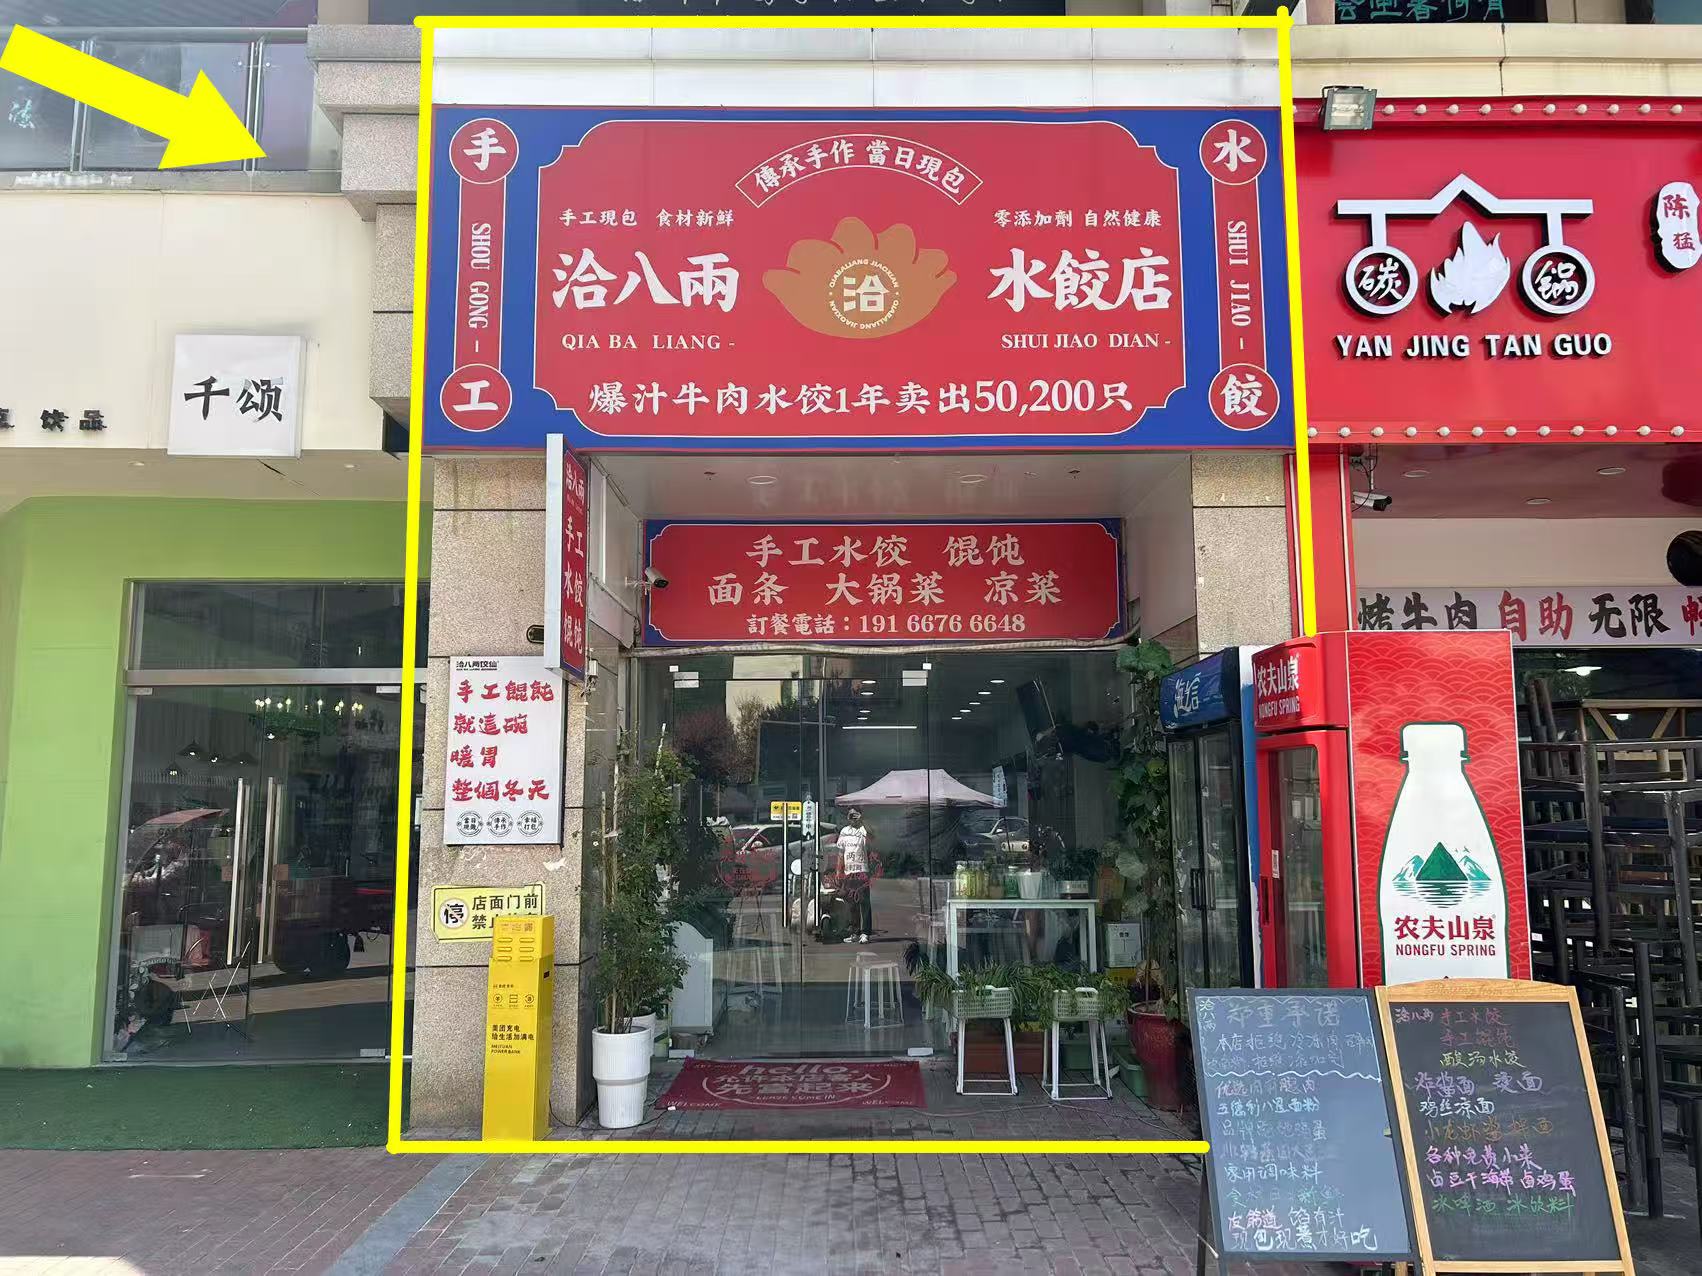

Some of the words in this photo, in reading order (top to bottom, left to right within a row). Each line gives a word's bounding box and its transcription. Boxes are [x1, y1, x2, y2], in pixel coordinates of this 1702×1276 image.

[463, 127, 507, 171] 手
[1212, 129, 1257, 172] 水
[755, 139, 854, 192] 傳承手作
[866, 139, 965, 194] 當日現包
[559, 208, 638, 227] 手工現包
[656, 208, 734, 228] 食材新鮮
[993, 209, 1073, 228] 零添加劑
[1084, 209, 1162, 228] 自然健康
[471, 222, 492, 271] SHOU
[1227, 220, 1248, 266] SHUI
[552, 248, 739, 313] 洽八兩
[987, 246, 1172, 313] 水餃店
[1358, 258, 1403, 301] 碳
[468, 280, 490, 329] GONG
[1230, 280, 1251, 326] JIAO
[562, 334, 600, 350] QIA
[608, 334, 637, 350] BA
[652, 334, 721, 350] LIANG
[1001, 334, 1049, 349] SHUI
[1053, 334, 1098, 349] JIAO
[1108, 334, 1160, 348] DIAN
[1336, 335, 1393, 358] YAN
[1406, 335, 1469, 358] JING
[1484, 335, 1541, 357] TAN
[1554, 333, 1612, 356] GUO
[183, 375, 285, 423] 千颂
[452, 379, 499, 412] 工
[588, 378, 1134, 416] 爆汁牛肉水饺1年卖出50,200只
[1220, 373, 1268, 417] 餃
[745, 534, 912, 568] 手工水饺
[942, 534, 1025, 567] 馄饨
[707, 573, 789, 606] 面条
[824, 572, 945, 606] 大锅菜
[906, 614, 963, 634] 6676
[968, 614, 1026, 634] 6648
[1357, 591, 1478, 631] 烤牛肉
[1498, 590, 1574, 642] 自助
[1257, 653, 1299, 699] 农夫山泉
[1258, 702, 1278, 719] NONGFU
[1278, 697, 1300, 713] SPRING
[450, 744, 498, 769] 暖胃
[452, 777, 550, 802] 整個冬天
[472, 893, 538, 911] 店面门前
[1394, 915, 1496, 941] 农夫山泉
[1396, 944, 1445, 956] NONGFU
[1450, 944, 1496, 956] SPRING
[1226, 1001, 1340, 1028] 郑重承诺
